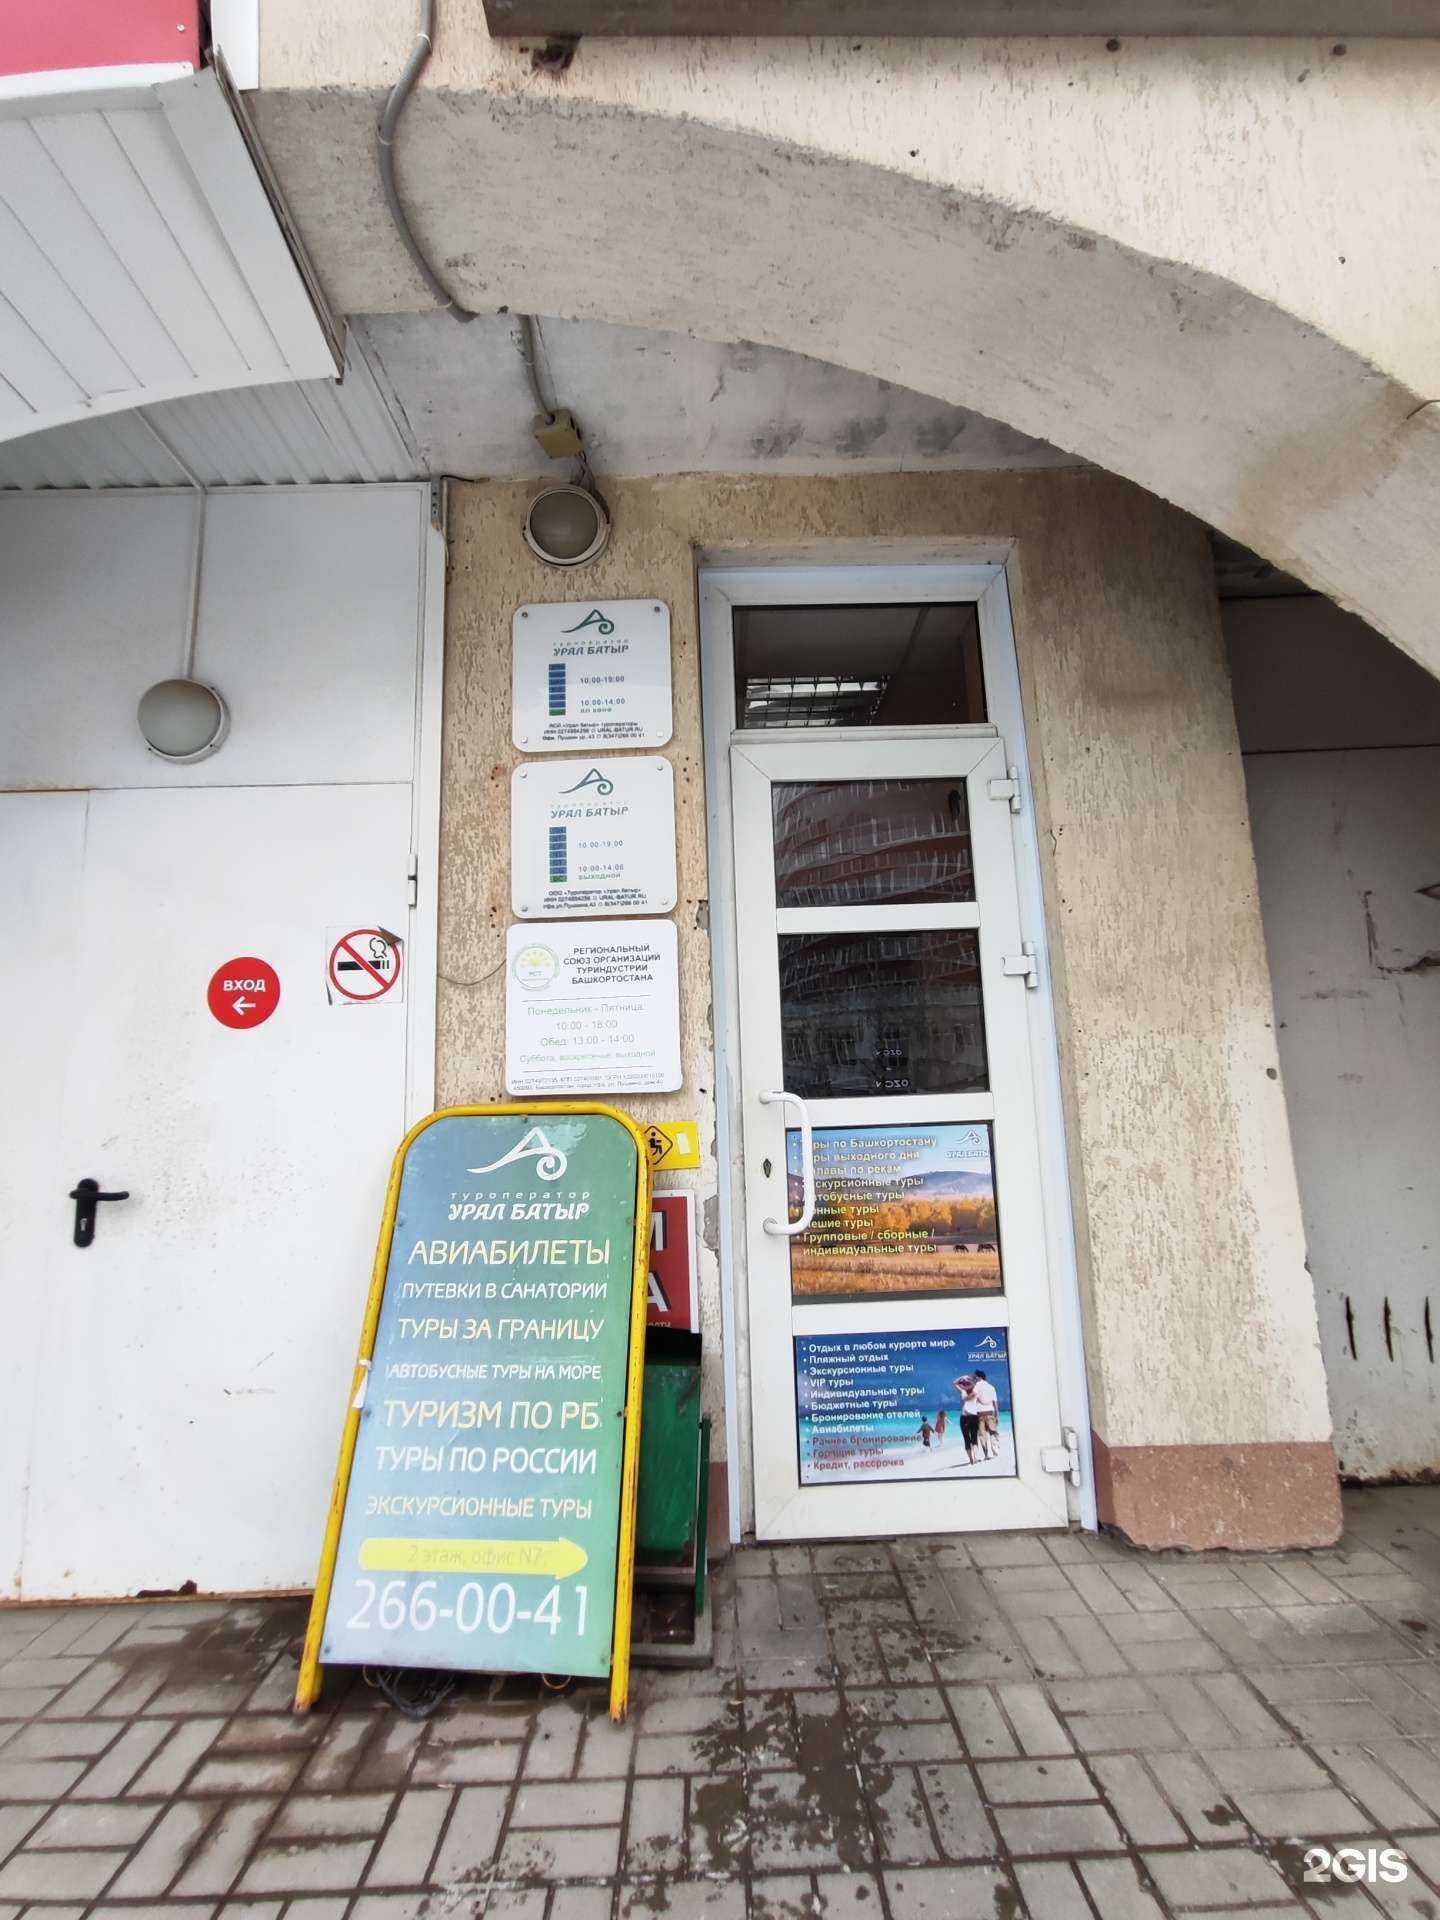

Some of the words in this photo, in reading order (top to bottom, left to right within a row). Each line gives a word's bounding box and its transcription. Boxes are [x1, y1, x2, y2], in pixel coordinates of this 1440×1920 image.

[553, 646, 584, 656] УРАЛ
[587, 645, 629, 655] БАТЫР
[551, 808, 582, 819] УРАЛ
[586, 806, 629, 817] БАТЫР
[574, 944, 650, 954] РЕГИОНАЛЬНЫЙ
[563, 956, 591, 965] СОЮЗ
[572, 974, 653, 984] БАШКОРТОСТАНА
[223, 979, 267, 992] ВХОД
[528, 1006, 591, 1016] Понедельник
[601, 1003, 644, 1013] Пятница
[557, 1022, 582, 1030] 10:00
[608, 1034, 635, 1043] 14:00
[850, 1137, 937, 1149] Башкортостану
[834, 1152, 895, 1161] выходного
[899, 1152, 920, 1161] дня
[868, 1165, 900, 1175] рекам
[804, 1178, 892, 1189] скурсионные
[895, 1177, 924, 1187] туры
[450, 1191, 590, 1200] туроператор
[875, 1191, 905, 1201] туры
[448, 1203, 504, 1220] УРАЛ
[510, 1202, 590, 1220] БАТЫР
[850, 1205, 880, 1215] туры
[844, 1219, 874, 1228] туры
[803, 1231, 868, 1243] Групповые
[877, 1229, 928, 1240] сборные
[408, 1240, 610, 1265] АВИАБИЛЕТЫ
[803, 1245, 901, 1256] индивидуальные
[902, 1244, 937, 1253] туры
[401, 1283, 481, 1299] ПУТЕВКИ
[485, 1283, 497, 1299] В
[500, 1282, 608, 1299] САНАТОРИИ
[398, 1318, 458, 1340] ТУРЫ
[462, 1318, 492, 1340] ЗА
[498, 1318, 605, 1342] ГРАНИЦУ
[809, 1344, 841, 1353] Отдых
[852, 1341, 886, 1350] любом
[889, 1341, 926, 1350] курорте
[930, 1340, 954, 1349] мира
[810, 1354, 856, 1364] Пляжный
[858, 1354, 889, 1363] отдых
[388, 1364, 488, 1380] АВТОБУСНЫЕ
[492, 1364, 531, 1380] ТУРЫ
[535, 1365, 556, 1380] НА
[558, 1364, 601, 1380] МОРЕ
[810, 1366, 887, 1376] Экскурсионные
[889, 1364, 914, 1373] туры
[828, 1378, 854, 1388] туры
[811, 1388, 898, 1399] Индивидуальные
[900, 1387, 925, 1396] туры
[811, 1401, 870, 1411] Бюджетные
[872, 1400, 897, 1409] туры
[384, 1401, 502, 1428] ТУРИЗМ
[510, 1401, 552, 1428] ПО
[561, 1401, 599, 1430] РБ
[812, 1413, 884, 1422] Бронирование
[887, 1410, 920, 1419] отелей
[812, 1425, 874, 1434] Авиабилеты
[813, 1437, 848, 1446] Раннее
[850, 1435, 921, 1445] бронирование
[813, 1449, 856, 1458] Горящие
[859, 1448, 884, 1457] туры
[375, 1447, 442, 1472] ТУРЫ
[449, 1448, 486, 1473] ПО
[493, 1448, 596, 1474] РОССИИ
[853, 1459, 904, 1468] рассрочка
[365, 1496, 534, 1518] ЭКСКУРСИОННЫЕ
[540, 1499, 592, 1519] ТУРЫ
[408, 1544, 418, 1562] 2
[424, 1548, 466, 1565] этаж,
[472, 1548, 513, 1566] офис
[346, 1579, 589, 1636] 266-00-41
